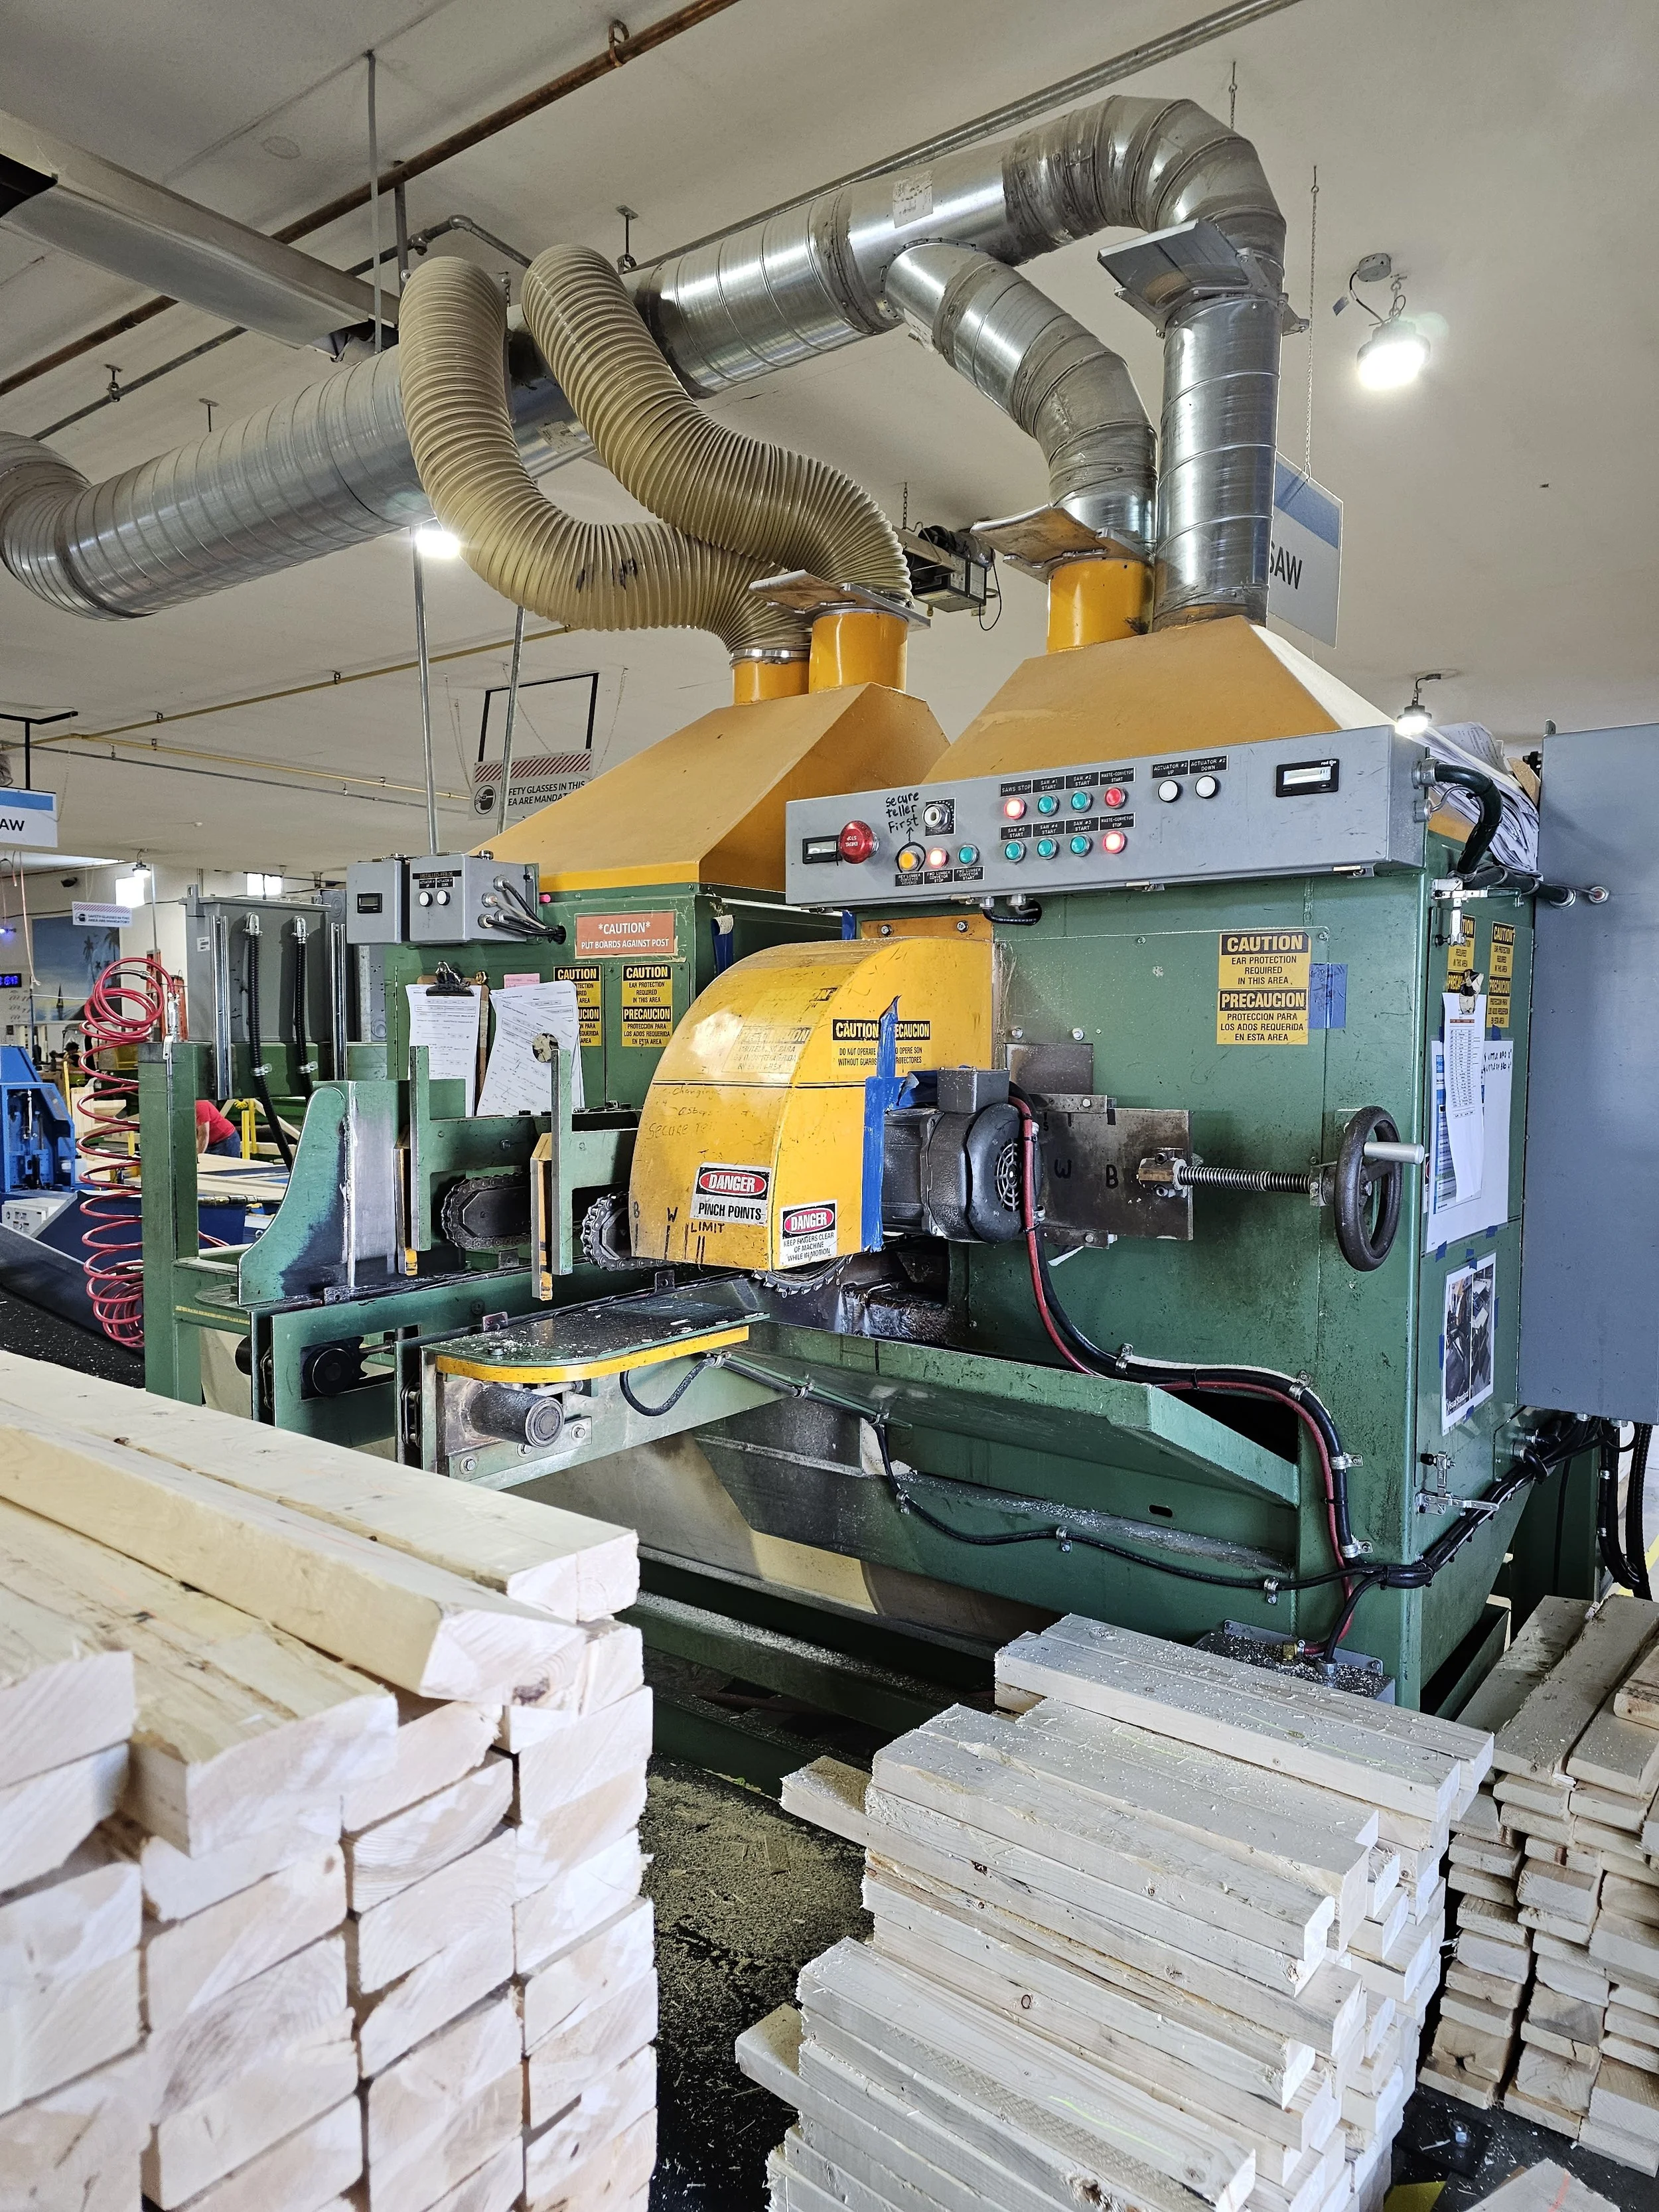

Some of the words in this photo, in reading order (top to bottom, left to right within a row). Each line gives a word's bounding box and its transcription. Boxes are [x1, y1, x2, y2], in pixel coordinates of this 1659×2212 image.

[508, 786, 526, 796] FETY
[527, 784, 557, 794] GLASSES
[559, 782, 567, 790] IN
[568, 780, 585, 790] THIS
[518, 796, 534, 805] ARE
[534, 792, 569, 803] MANDAT
[885, 804, 917, 818] teller
[0, 818, 25, 832] AW
[888, 814, 918, 834] First
[1462, 919, 1475, 935] TION
[1494, 926, 1513, 942] CAUTION
[622, 939, 650, 948] AGAINST
[1227, 934, 1303, 952] CAUTION
[557, 968, 597, 980] CAUTION
[626, 966, 668, 979] CAUTION
[1222, 992, 1305, 1008] PRECAUCION
[624, 1008, 670, 1020] PRECAUCION
[835, 1022, 879, 1038] CAUTION
[895, 1023, 929, 1038] ECAUCION
[838, 1058, 859, 1067] WITHOUT
[708, 1175, 755, 1193] DANGER
[1106, 1164, 1119, 1189] B
[667, 1207, 678, 1222] W
[698, 1203, 725, 1217] PINCH
[728, 1206, 762, 1220] POINTS
[691, 1222, 725, 1233] LIMIT
[790, 1212, 828, 1231] DANGER
[797, 1235, 818, 1244] FINGERS
[818, 1232, 834, 1240] CLEAR
[802, 1241, 824, 1250] MACHINE
[788, 1253, 803, 1262] WHILE
[810, 1248, 830, 1258] MOTION
